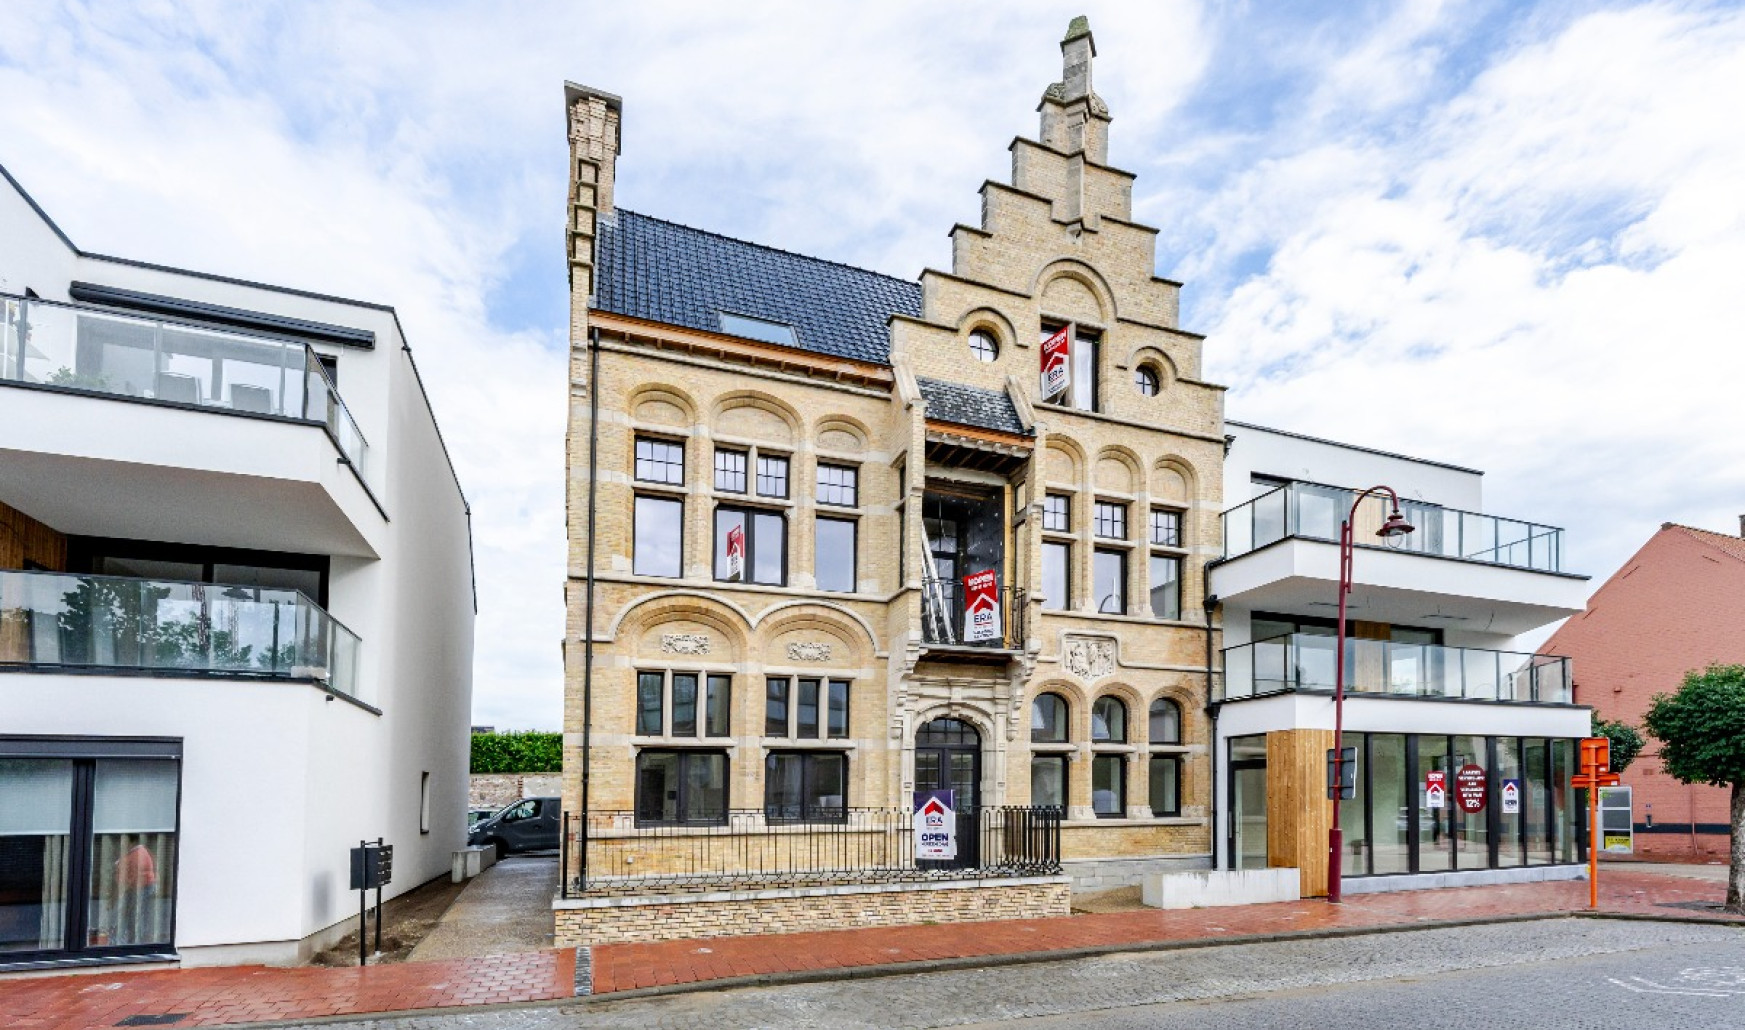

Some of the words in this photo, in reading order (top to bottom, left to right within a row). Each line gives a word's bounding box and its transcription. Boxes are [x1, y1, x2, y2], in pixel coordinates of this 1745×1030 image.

[1048, 367, 1063, 381] ERA
[974, 612, 992, 622] ERA
[1466, 799, 1480, 808] 12%
[922, 833, 948, 841] OPEN
